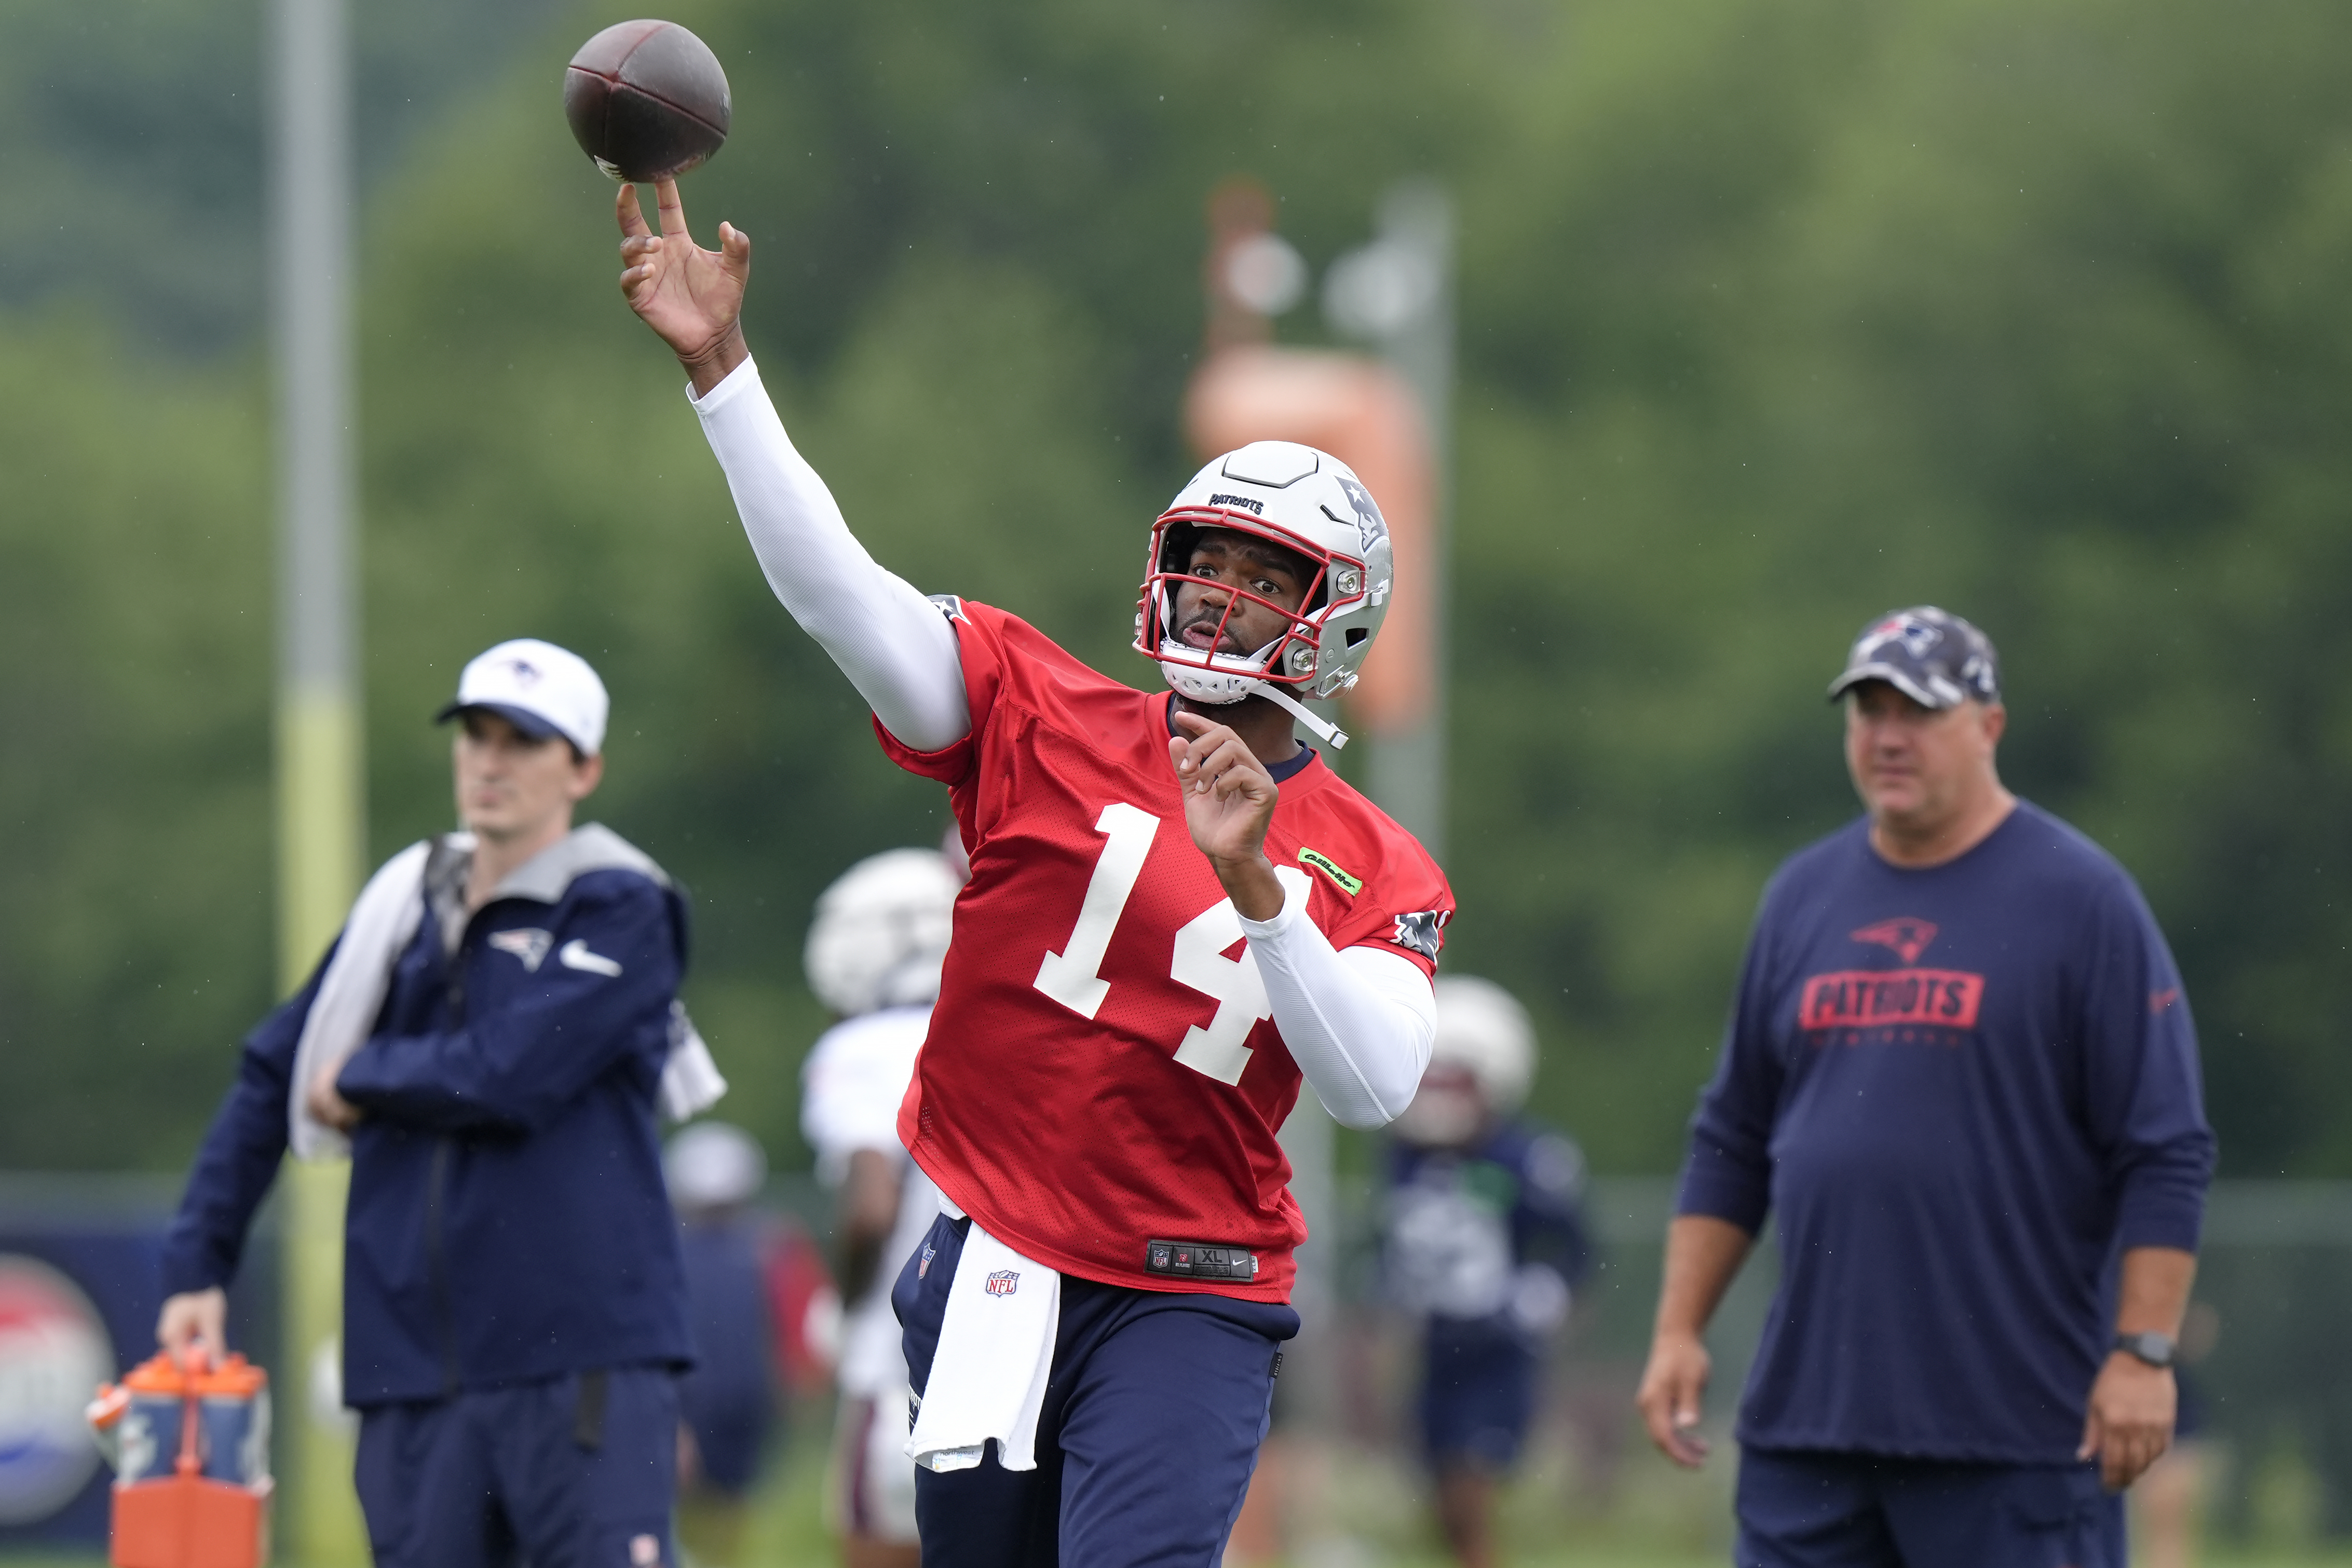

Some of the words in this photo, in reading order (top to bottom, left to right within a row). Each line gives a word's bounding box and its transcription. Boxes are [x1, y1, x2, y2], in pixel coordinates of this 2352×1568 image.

[1208, 494, 1263, 515] PATRIOTS
[1304, 854, 1356, 889] Gillette
[1033, 802, 1312, 1087] 14
[1202, 1250, 1222, 1263] XL
[988, 1279, 1013, 1293] NFL
